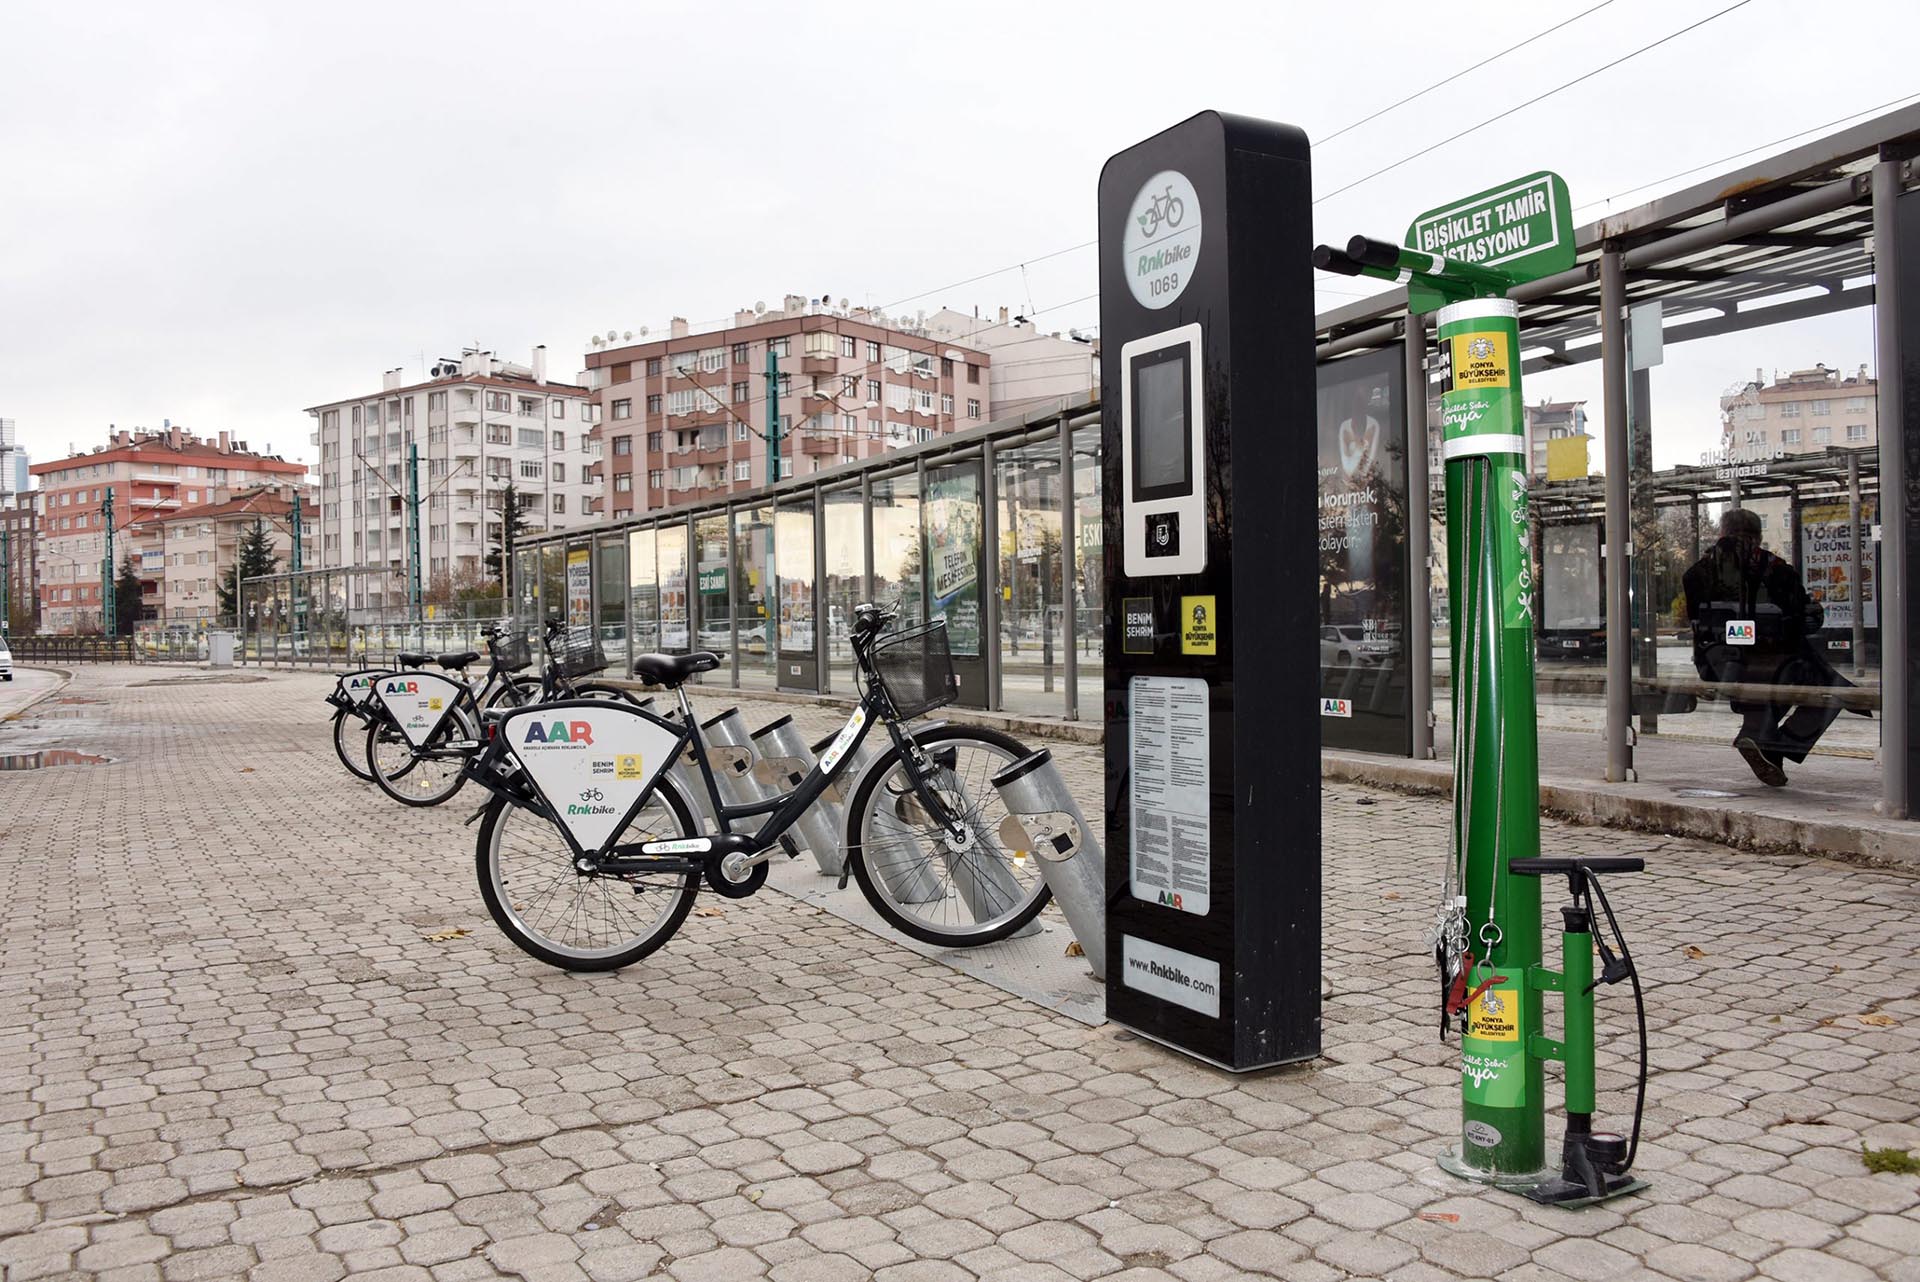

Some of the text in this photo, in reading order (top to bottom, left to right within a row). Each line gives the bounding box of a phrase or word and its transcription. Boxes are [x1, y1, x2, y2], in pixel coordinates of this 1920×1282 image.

[1424, 189, 1546, 251] BİSİKLET TAMİR
[1137, 245, 1191, 277] Rnkbike
[1150, 273, 1178, 297] 1069
[1459, 368, 1506, 380] BÜYÜKŞEHİR
[1814, 541, 1866, 552] ÜRÜNLR
[1127, 613, 1152, 624] BENİM
[1126, 625, 1153, 638] ŞEHRİM
[1728, 626, 1753, 638] AAR
[386, 682, 418, 693] AAR
[1325, 700, 1346, 713] AAR
[524, 721, 594, 745] AAR
[567, 804, 615, 815] Rnkbike
[1159, 890, 1183, 910] AAR
[1129, 957, 1215, 996] www.Rnkbike.com
